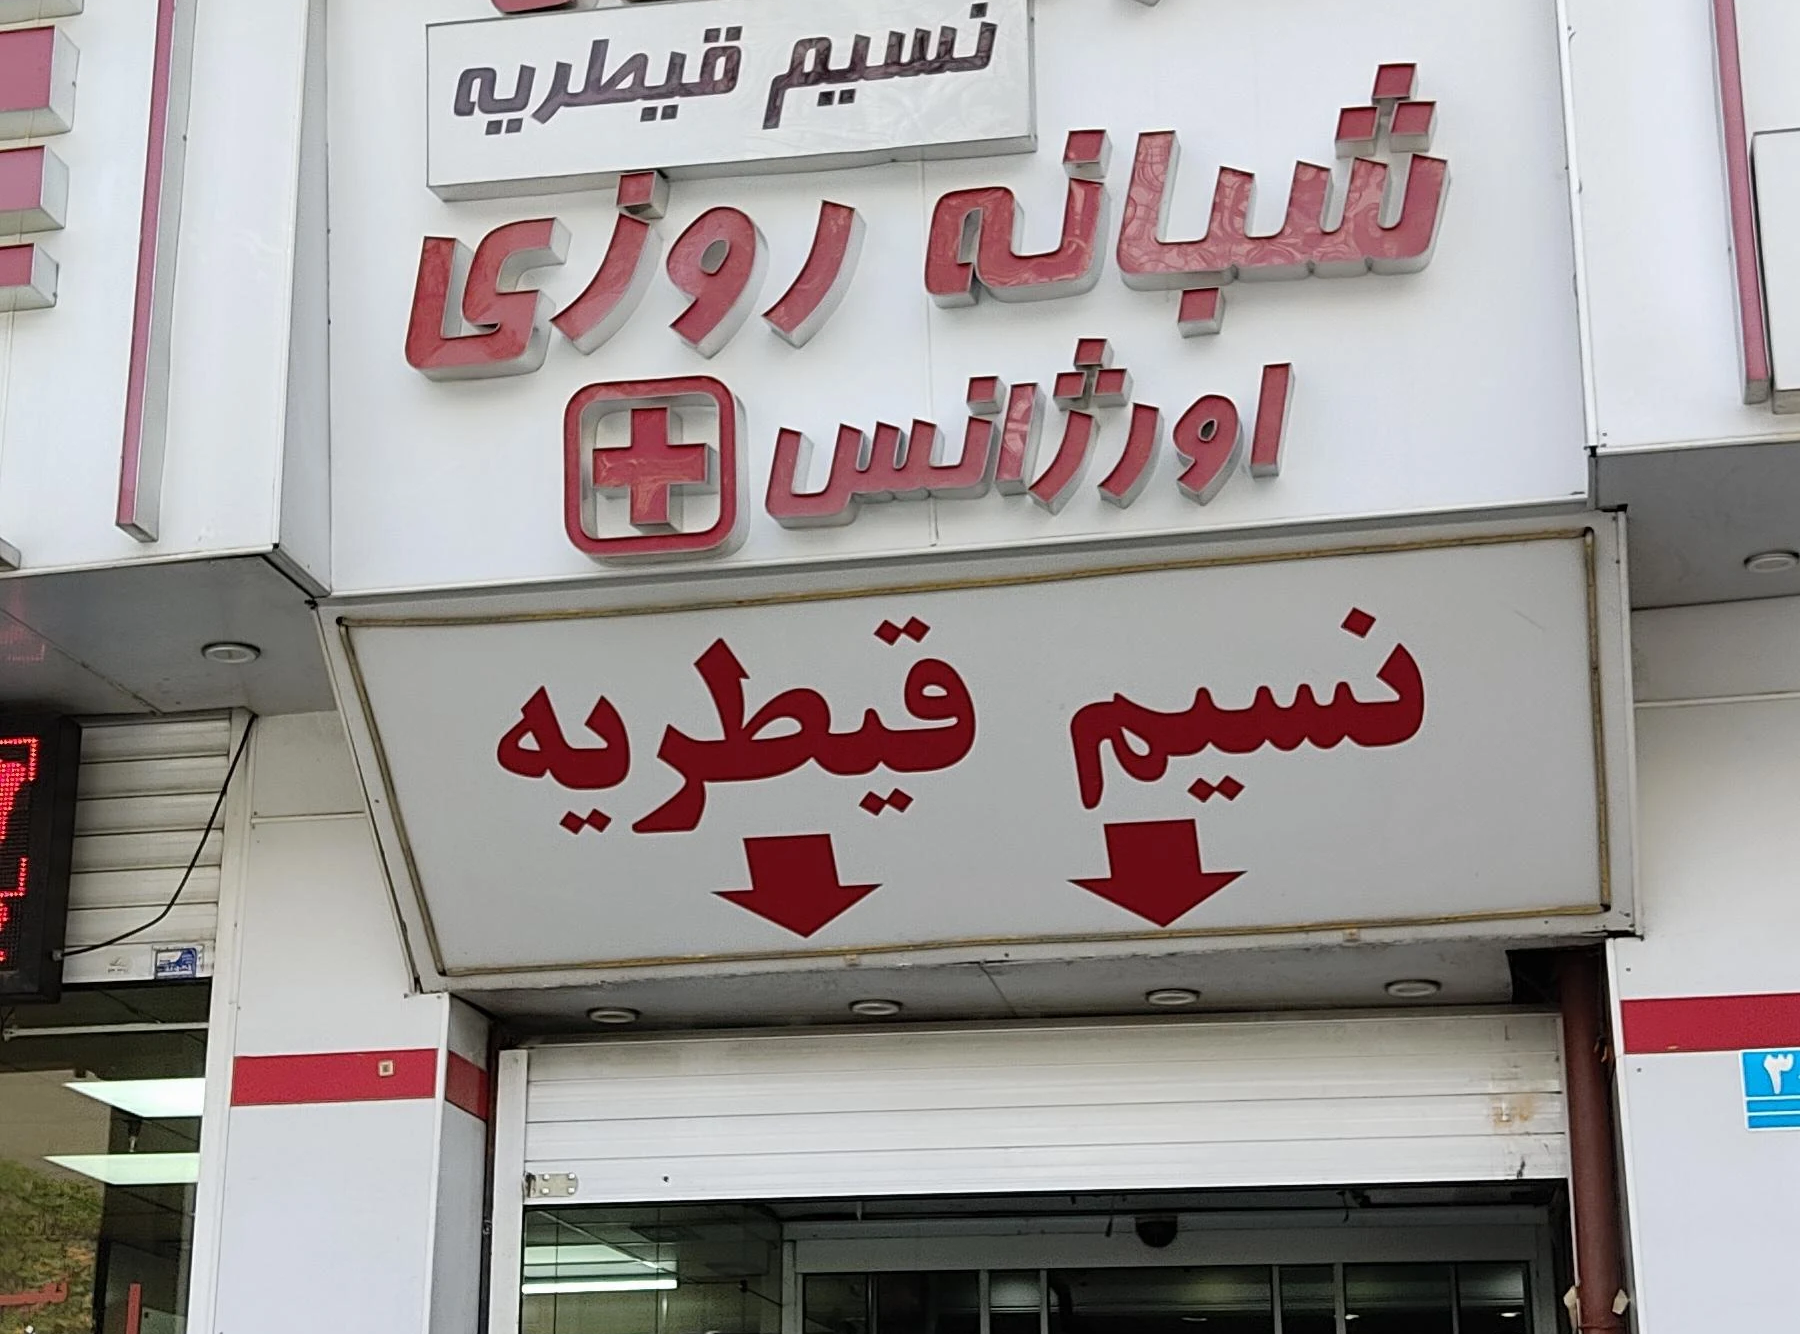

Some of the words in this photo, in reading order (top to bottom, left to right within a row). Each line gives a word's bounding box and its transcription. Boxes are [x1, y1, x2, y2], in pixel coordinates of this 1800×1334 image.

[453, 26, 742, 135] قیطریه
[762, 2, 998, 129] نسیم
[403, 171, 866, 381] روزی
[925, 62, 1450, 338] شبانه
[764, 337, 1296, 529] اورژانس
[496, 615, 977, 835] قیطریه
[1069, 607, 1426, 810] نسیم
[1763, 1053, 1800, 1095] ۳
